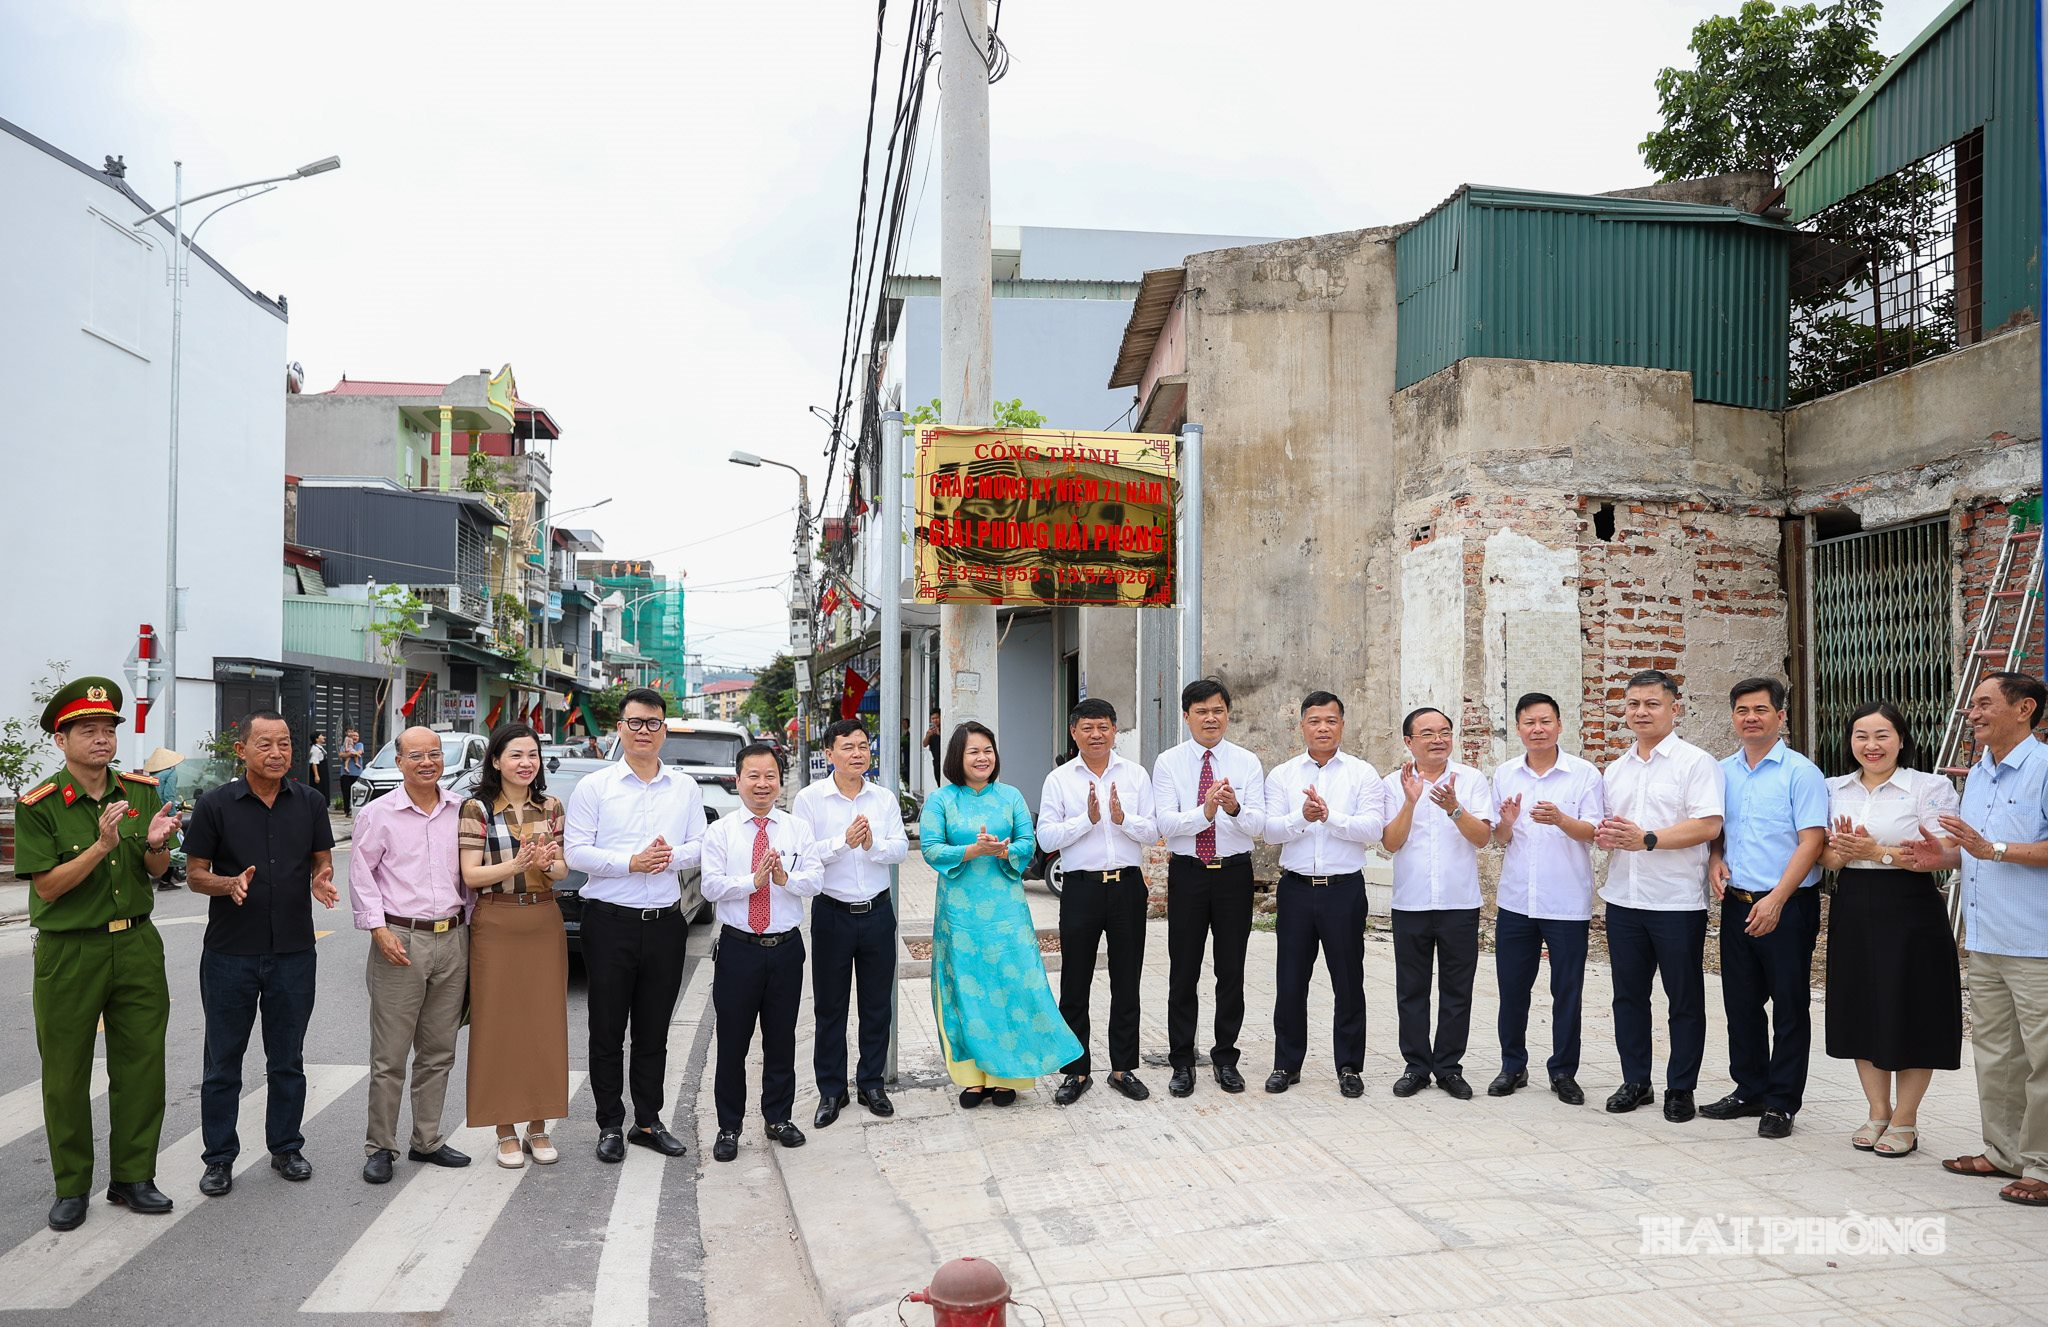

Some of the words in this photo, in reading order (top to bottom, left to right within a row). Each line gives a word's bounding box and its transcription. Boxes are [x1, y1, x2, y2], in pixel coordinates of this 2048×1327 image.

[974, 441, 1039, 462] CÔNG
[1046, 443, 1120, 465] TRÌNH
[1031, 470, 1050, 501] KỶ
[1056, 473, 1099, 508] NIỆM
[1102, 480, 1120, 503] 71
[1126, 476, 1163, 505] NĂM
[928, 510, 971, 548] GIẢI
[977, 516, 1049, 549] PHÓNG
[1054, 513, 1088, 551] HẢI
[1094, 518, 1163, 552] PHÒNG
[937, 563, 1040, 583] (13/5/1955
[1057, 566, 1156, 587] 13/5/2026)
